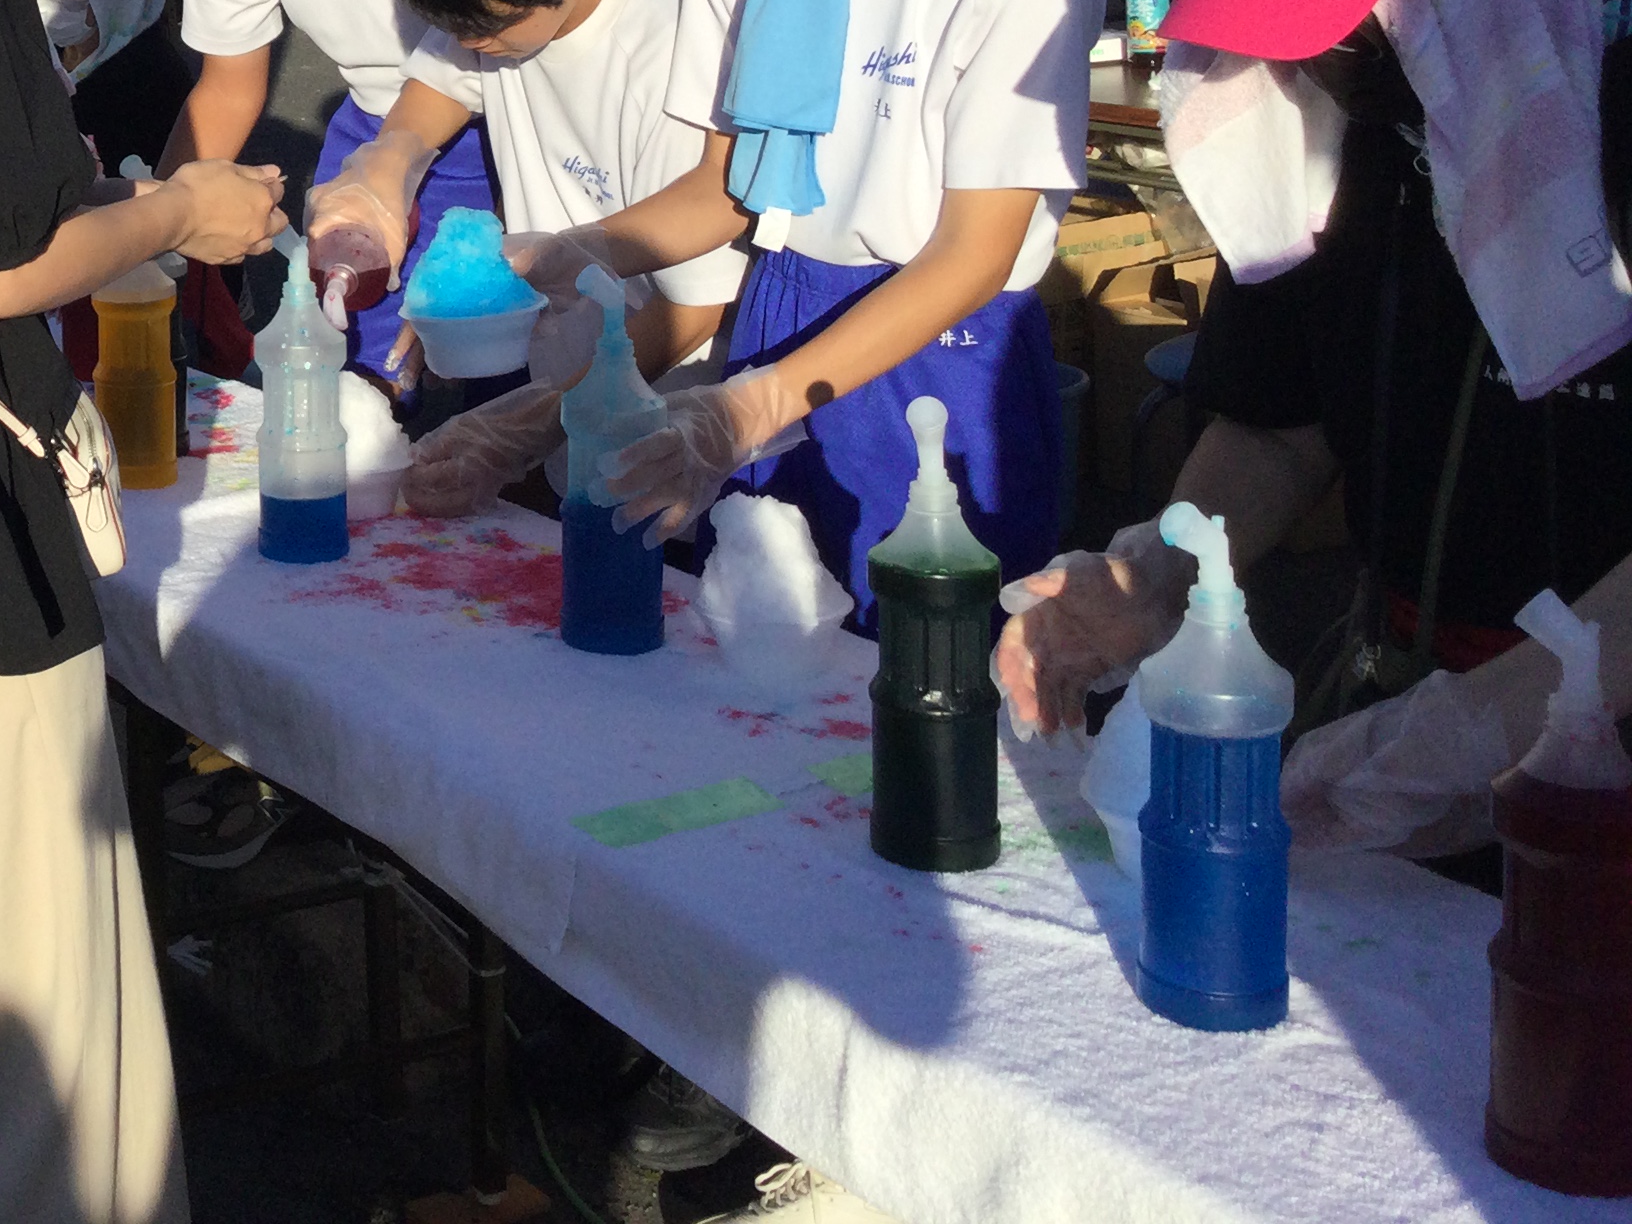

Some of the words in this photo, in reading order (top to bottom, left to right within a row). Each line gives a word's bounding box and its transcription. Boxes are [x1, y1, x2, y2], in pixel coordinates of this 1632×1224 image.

[861, 41, 918, 79] Hishi
[561, 155, 611, 184] Higai
[938, 329, 979, 348] 井上
